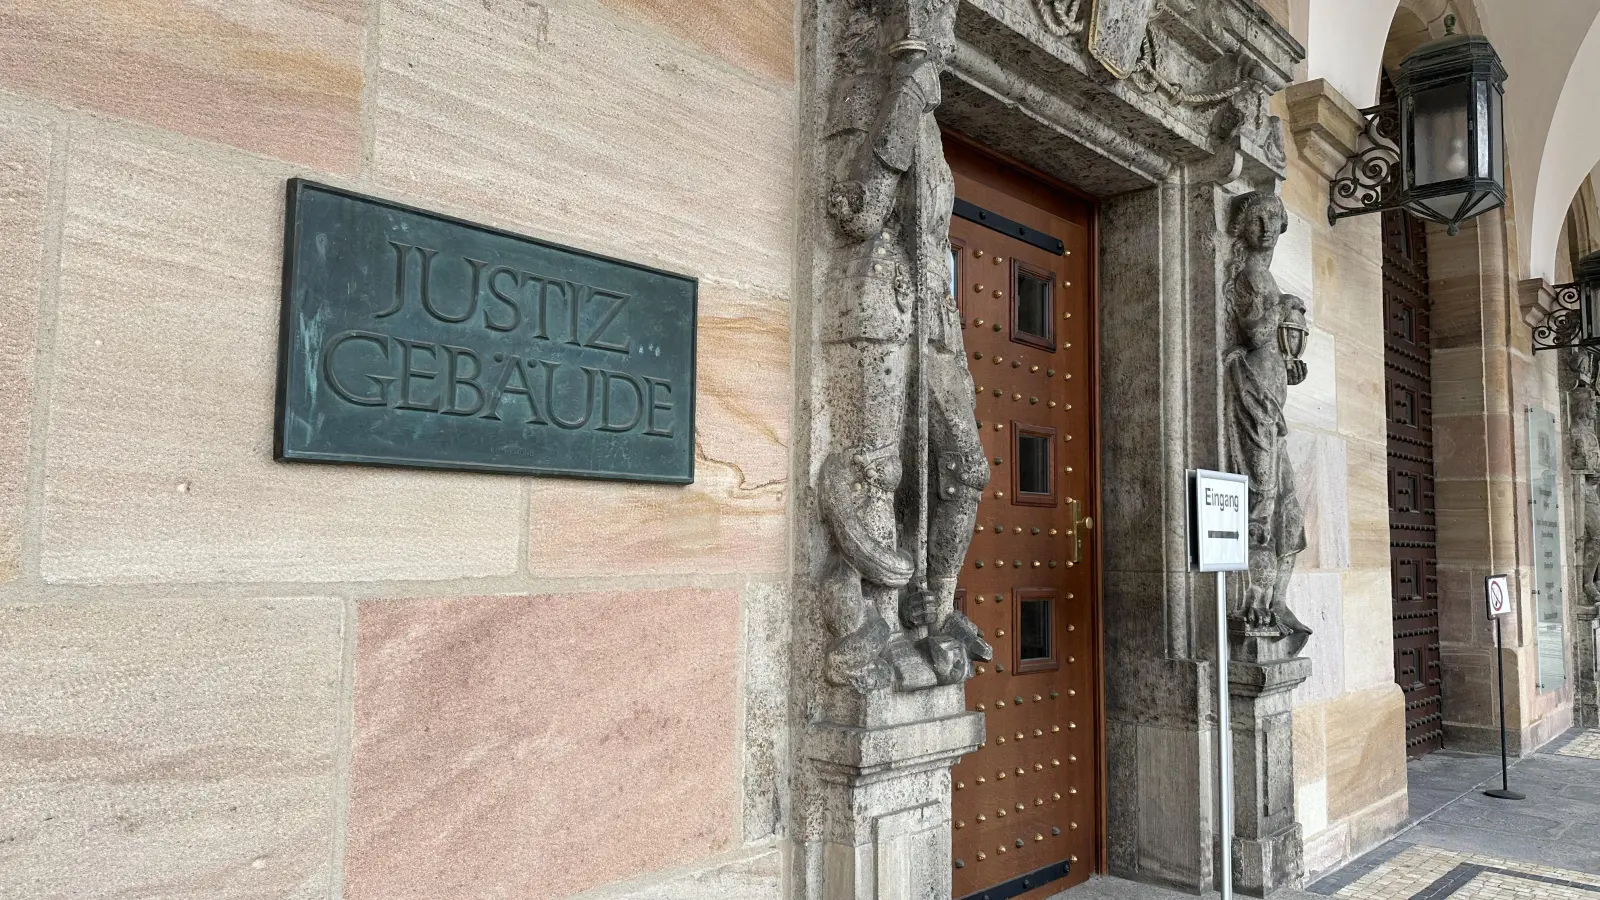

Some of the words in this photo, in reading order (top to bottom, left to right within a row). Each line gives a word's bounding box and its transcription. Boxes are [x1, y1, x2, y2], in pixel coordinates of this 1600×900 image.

[375, 241, 631, 353] JUSTIZ
[323, 331, 674, 437] GEBÄUDE
[1205, 487, 1239, 512] Eingang
